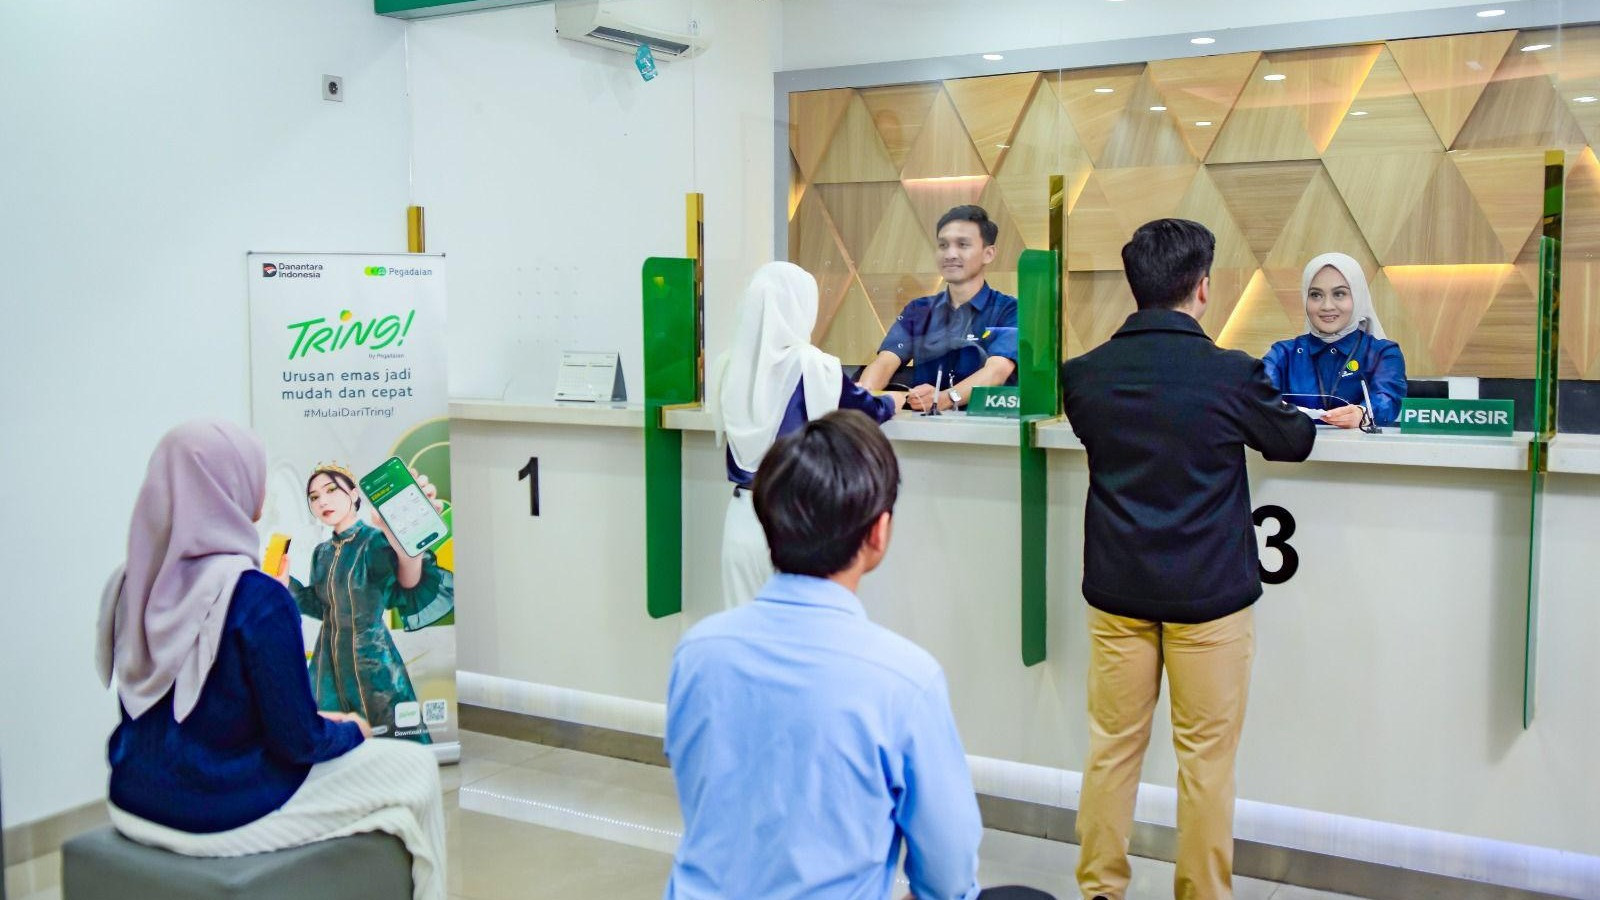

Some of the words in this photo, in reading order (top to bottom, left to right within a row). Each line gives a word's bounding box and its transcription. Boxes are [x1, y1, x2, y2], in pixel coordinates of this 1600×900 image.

[389, 267, 433, 277] Pegadaian
[283, 371, 334, 382] Urusan
[341, 371, 380, 381] emas
[385, 368, 411, 382] jadi
[282, 387, 332, 400] mudah
[339, 386, 365, 398] dan
[372, 386, 413, 400] cepat
[304, 407, 394, 418] #MulaiDariTring!
[1405, 409, 1508, 425] PENAKSIR
[518, 456, 540, 517] 1
[1251, 504, 1299, 585] 3
